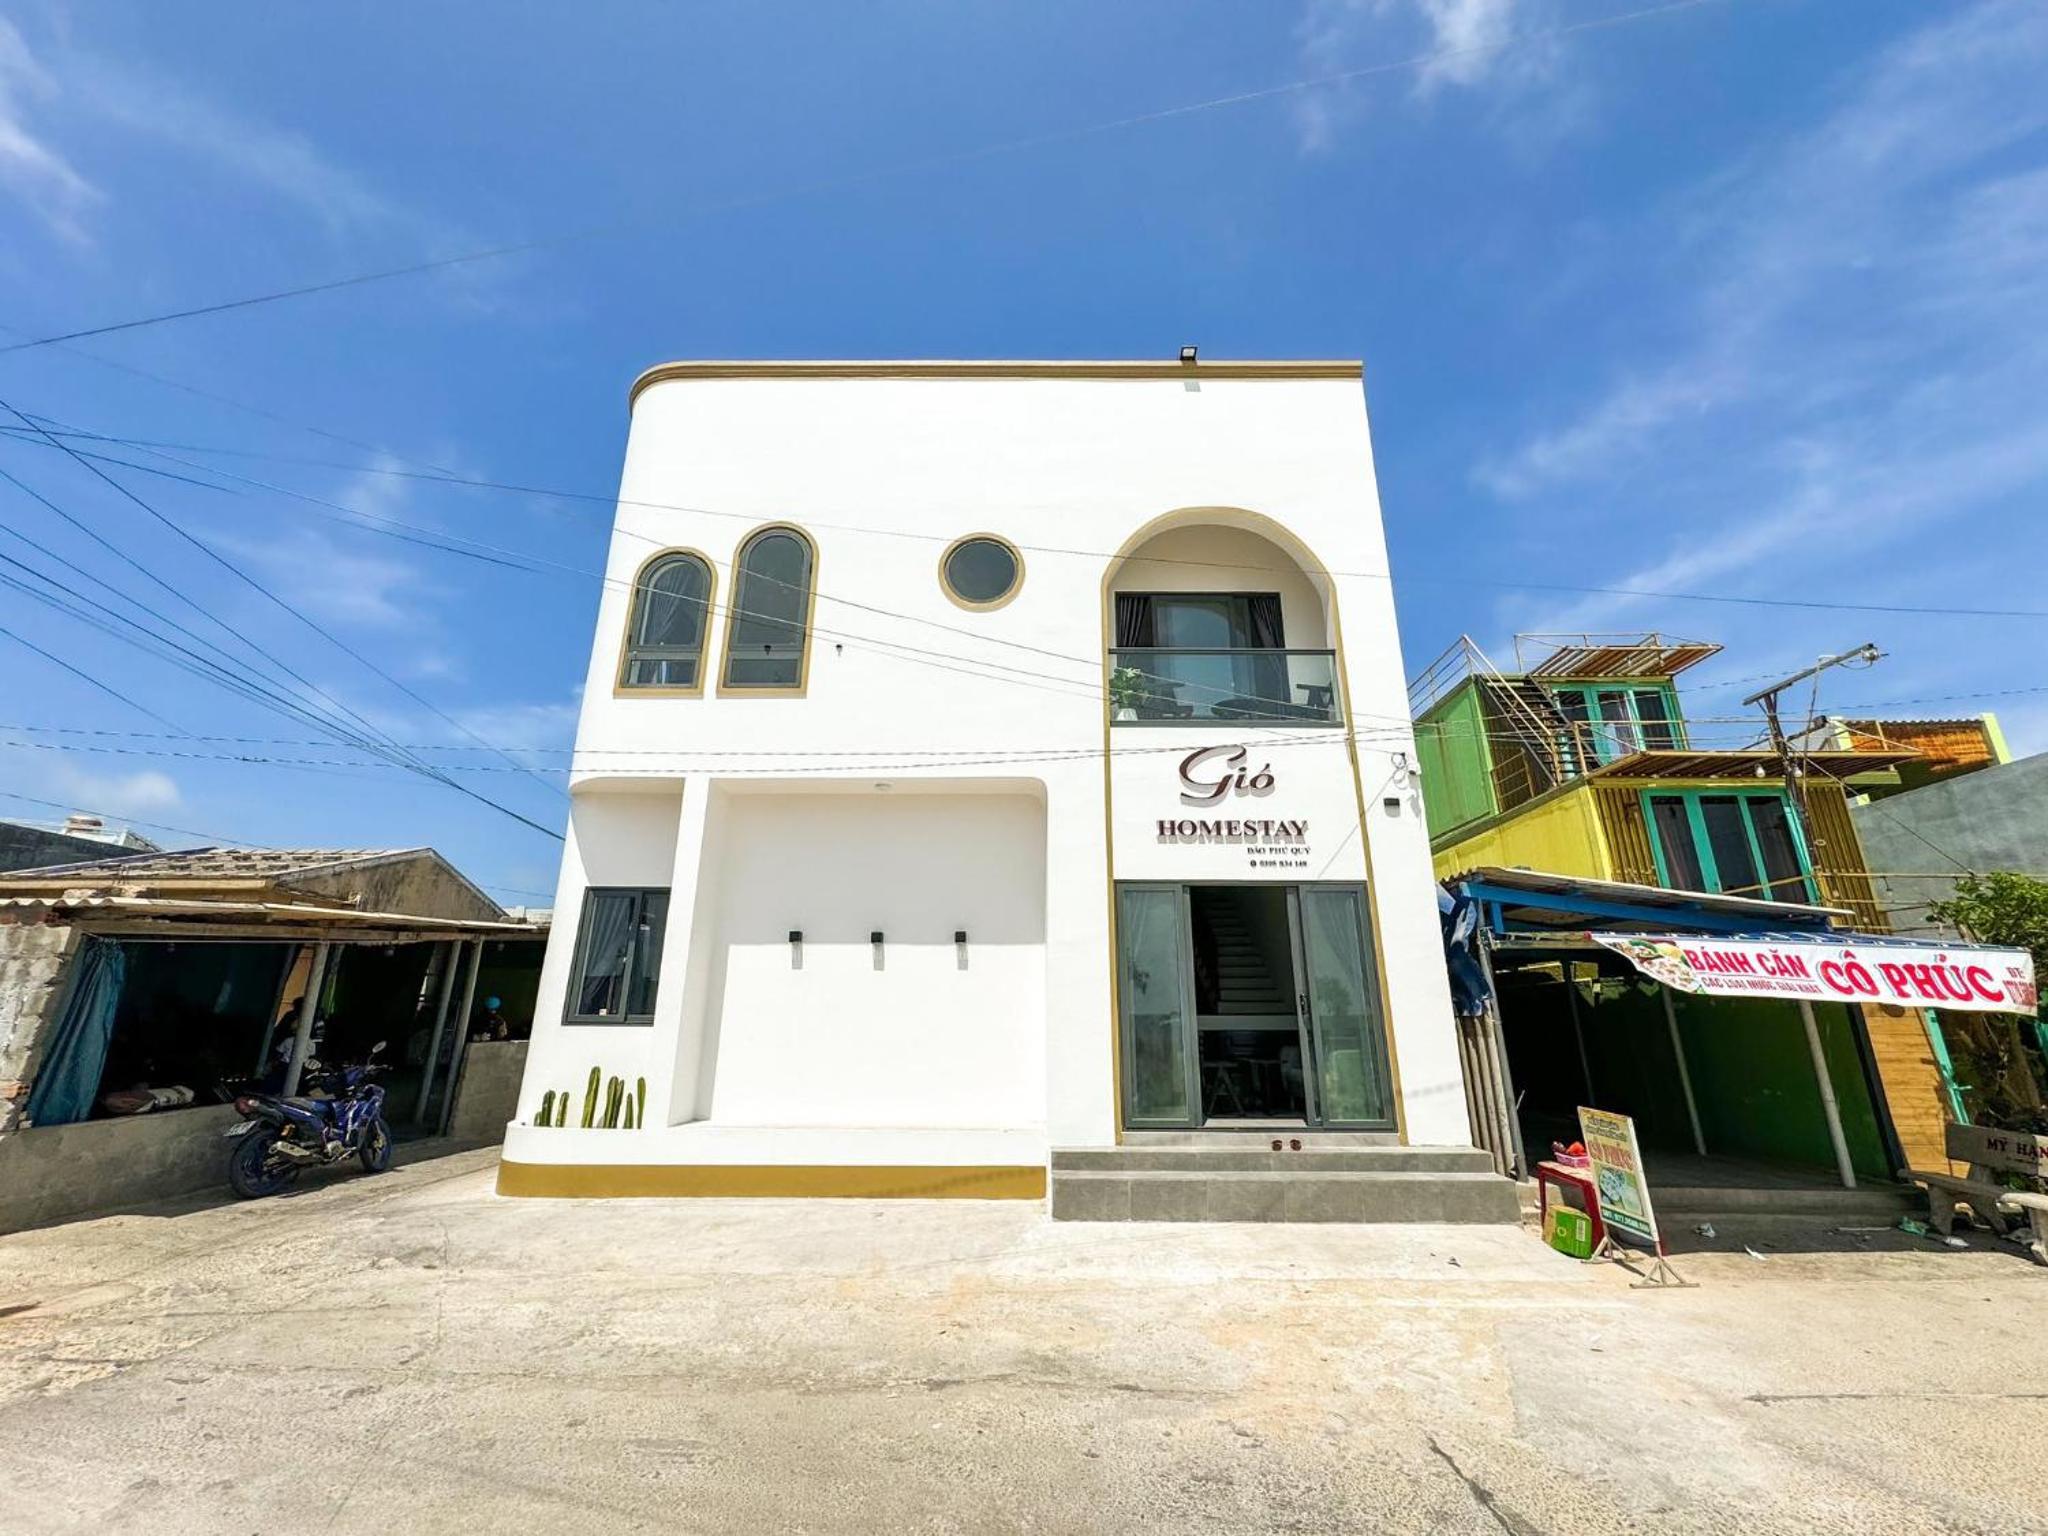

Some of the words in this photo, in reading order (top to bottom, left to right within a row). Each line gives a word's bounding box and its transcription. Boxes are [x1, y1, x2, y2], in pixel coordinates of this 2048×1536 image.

[1179, 744, 1275, 804] Gió
[1157, 819, 1309, 841] HOMESTAY
[1682, 946, 1757, 974] BÁNH
[1756, 948, 1811, 979] CĂN
[1817, 950, 1880, 996] CÔ
[1875, 953, 2005, 1003] PHÚC
